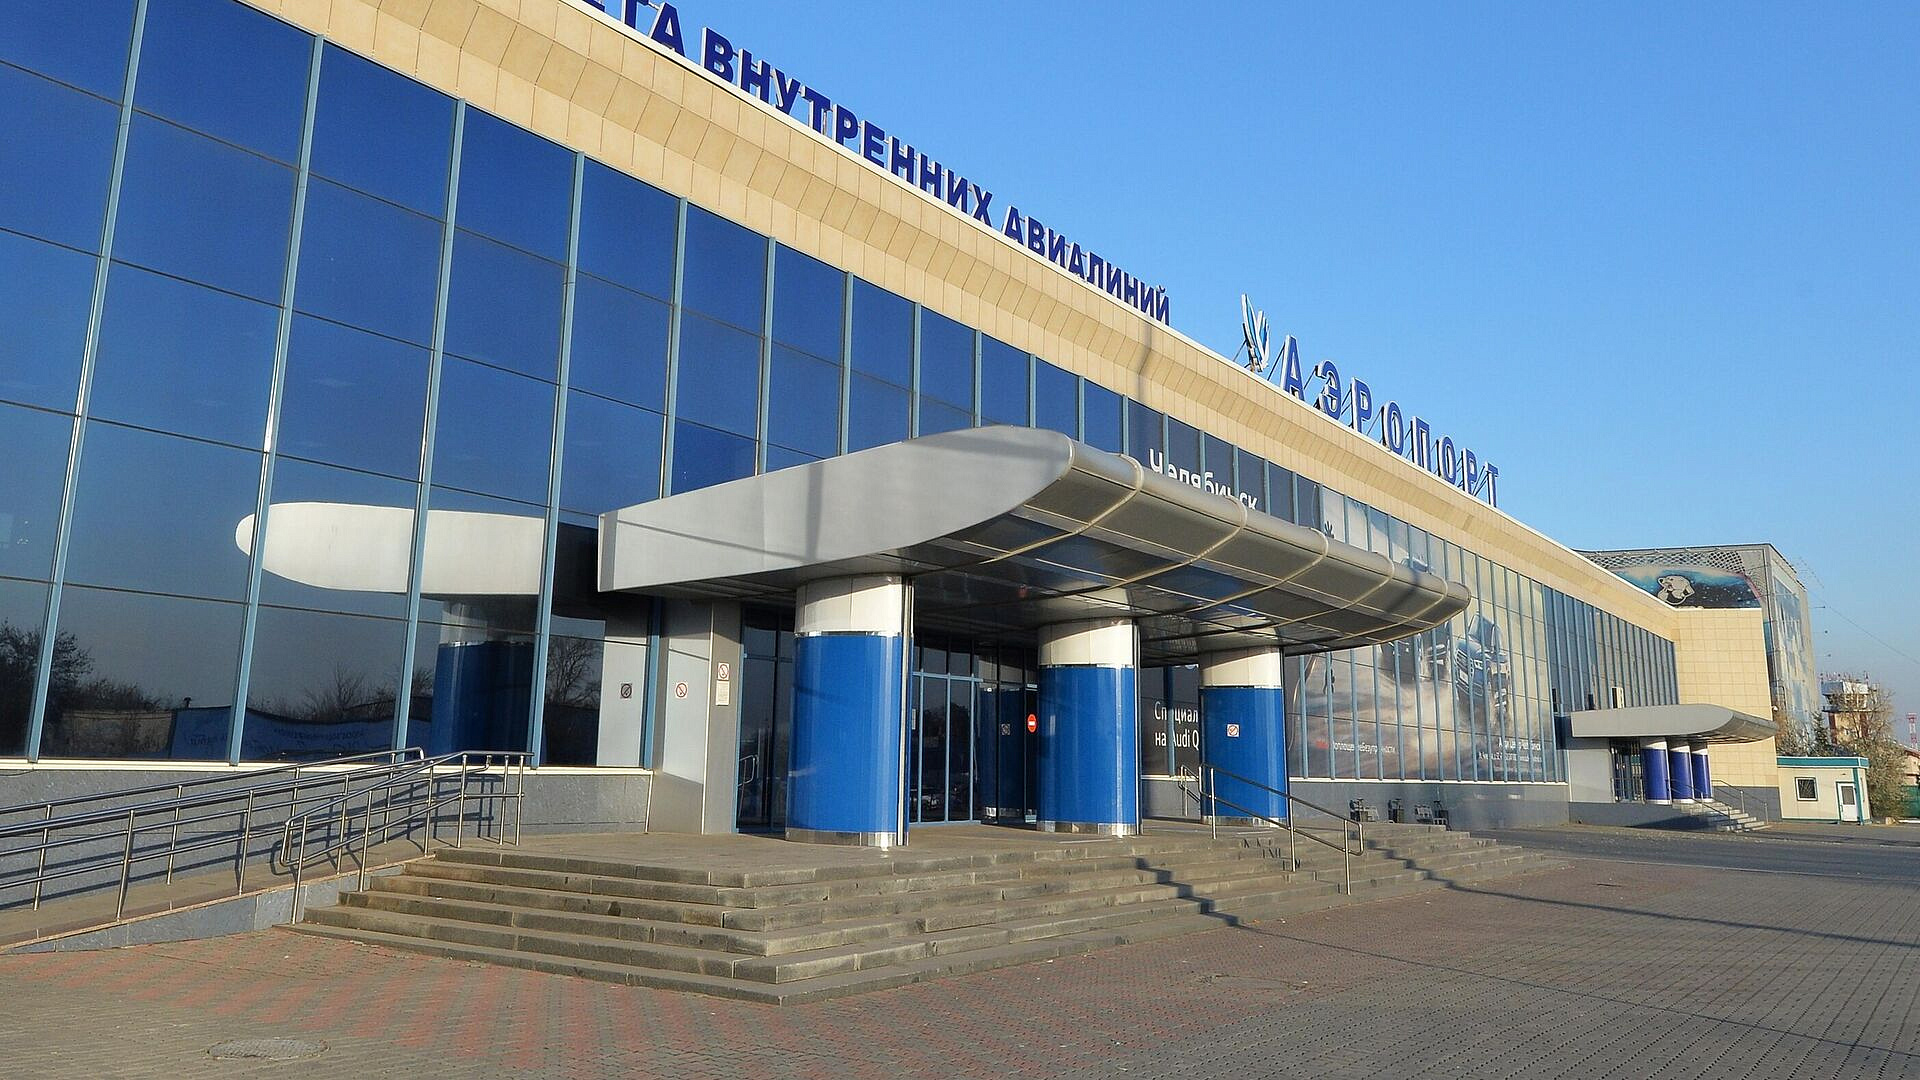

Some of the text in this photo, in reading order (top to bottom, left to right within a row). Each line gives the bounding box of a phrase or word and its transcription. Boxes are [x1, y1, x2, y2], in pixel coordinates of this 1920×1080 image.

[702, 27, 992, 228] ВНУТРЕННИХ
[1002, 205, 1170, 326] АВИАЛИНИЙ
[1280, 335, 1499, 508] АЭРОПОРТ
[1154, 701, 1199, 724] Спциал
[1155, 732, 1167, 747] на
